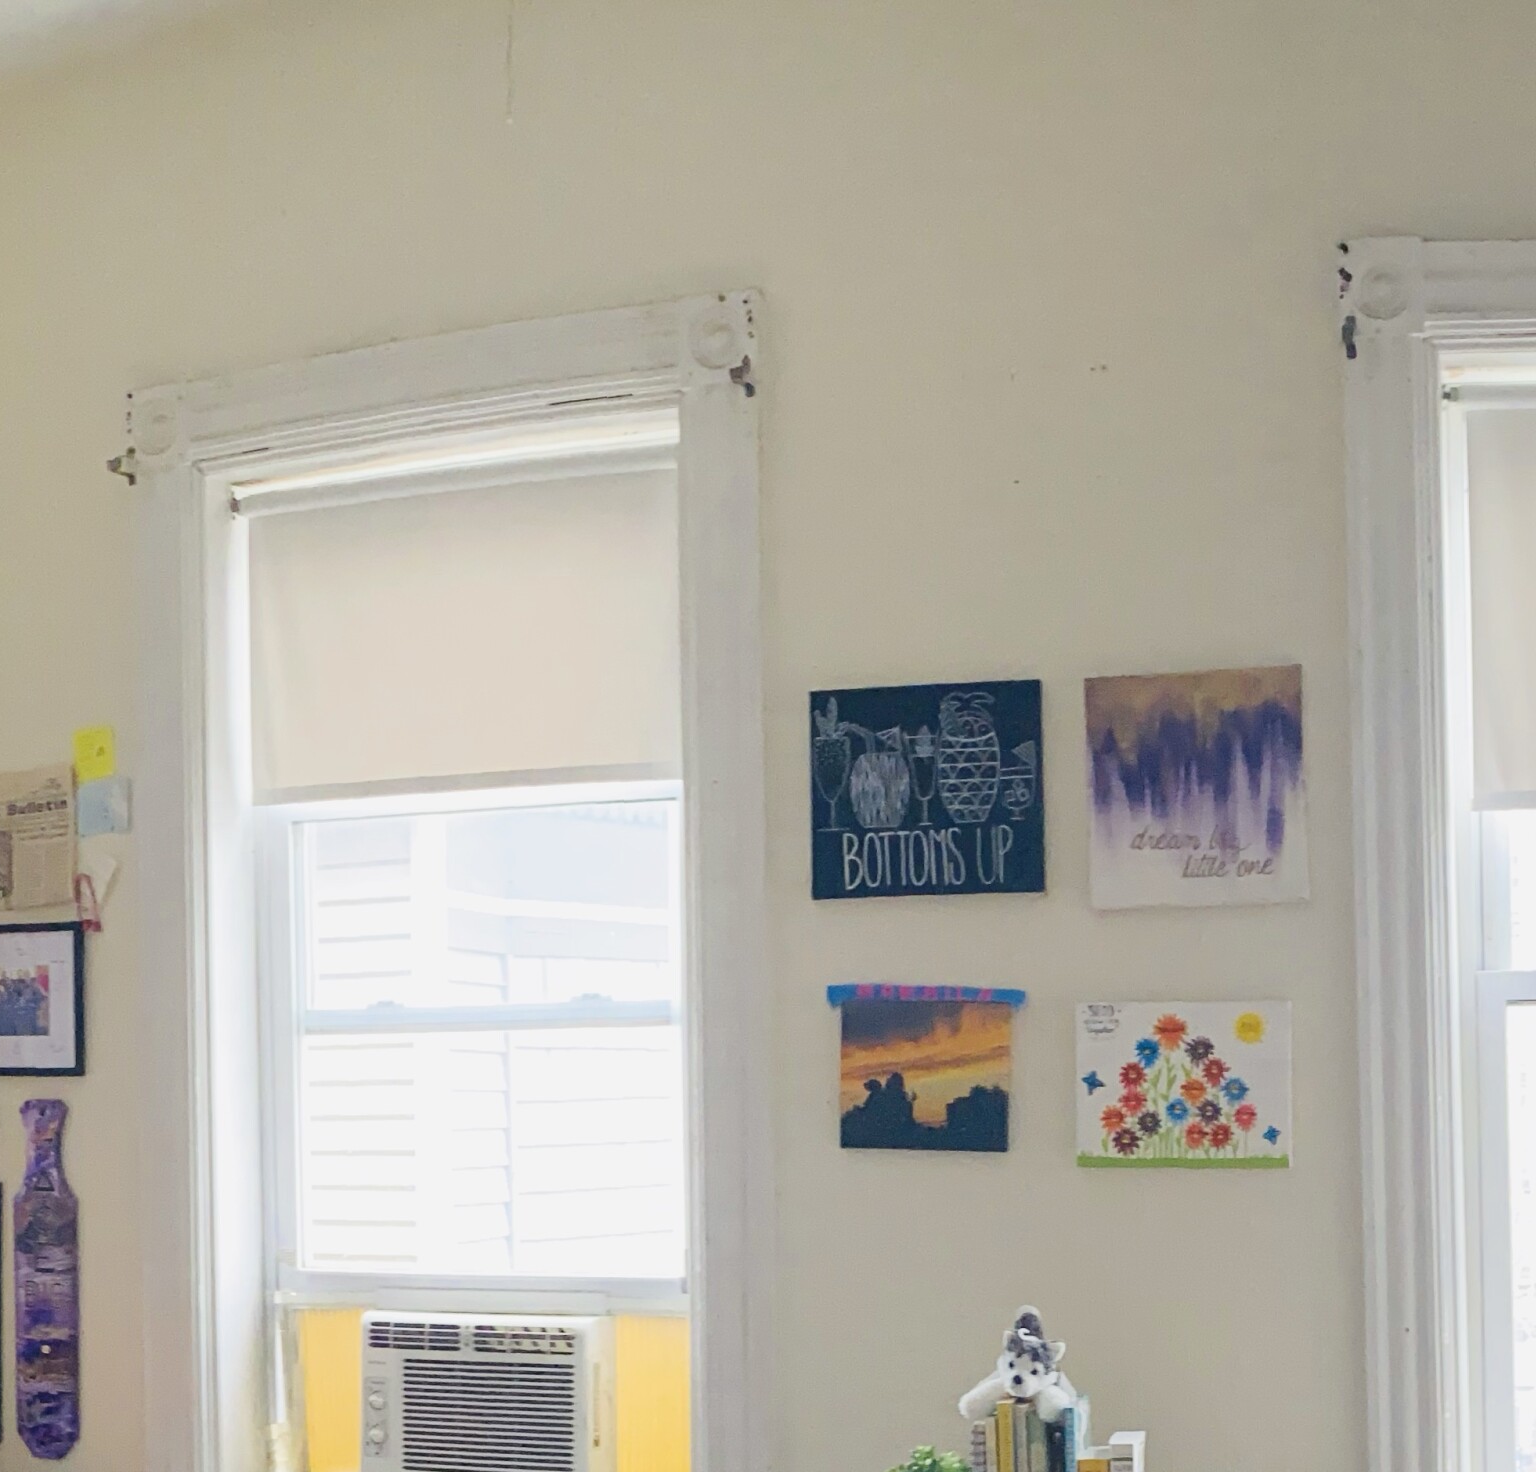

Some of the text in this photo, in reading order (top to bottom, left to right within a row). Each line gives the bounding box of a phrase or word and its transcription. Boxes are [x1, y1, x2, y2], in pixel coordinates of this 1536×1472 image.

[842, 824, 1014, 891] BOTTOMS UP
[1130, 825, 1202, 851] dream
